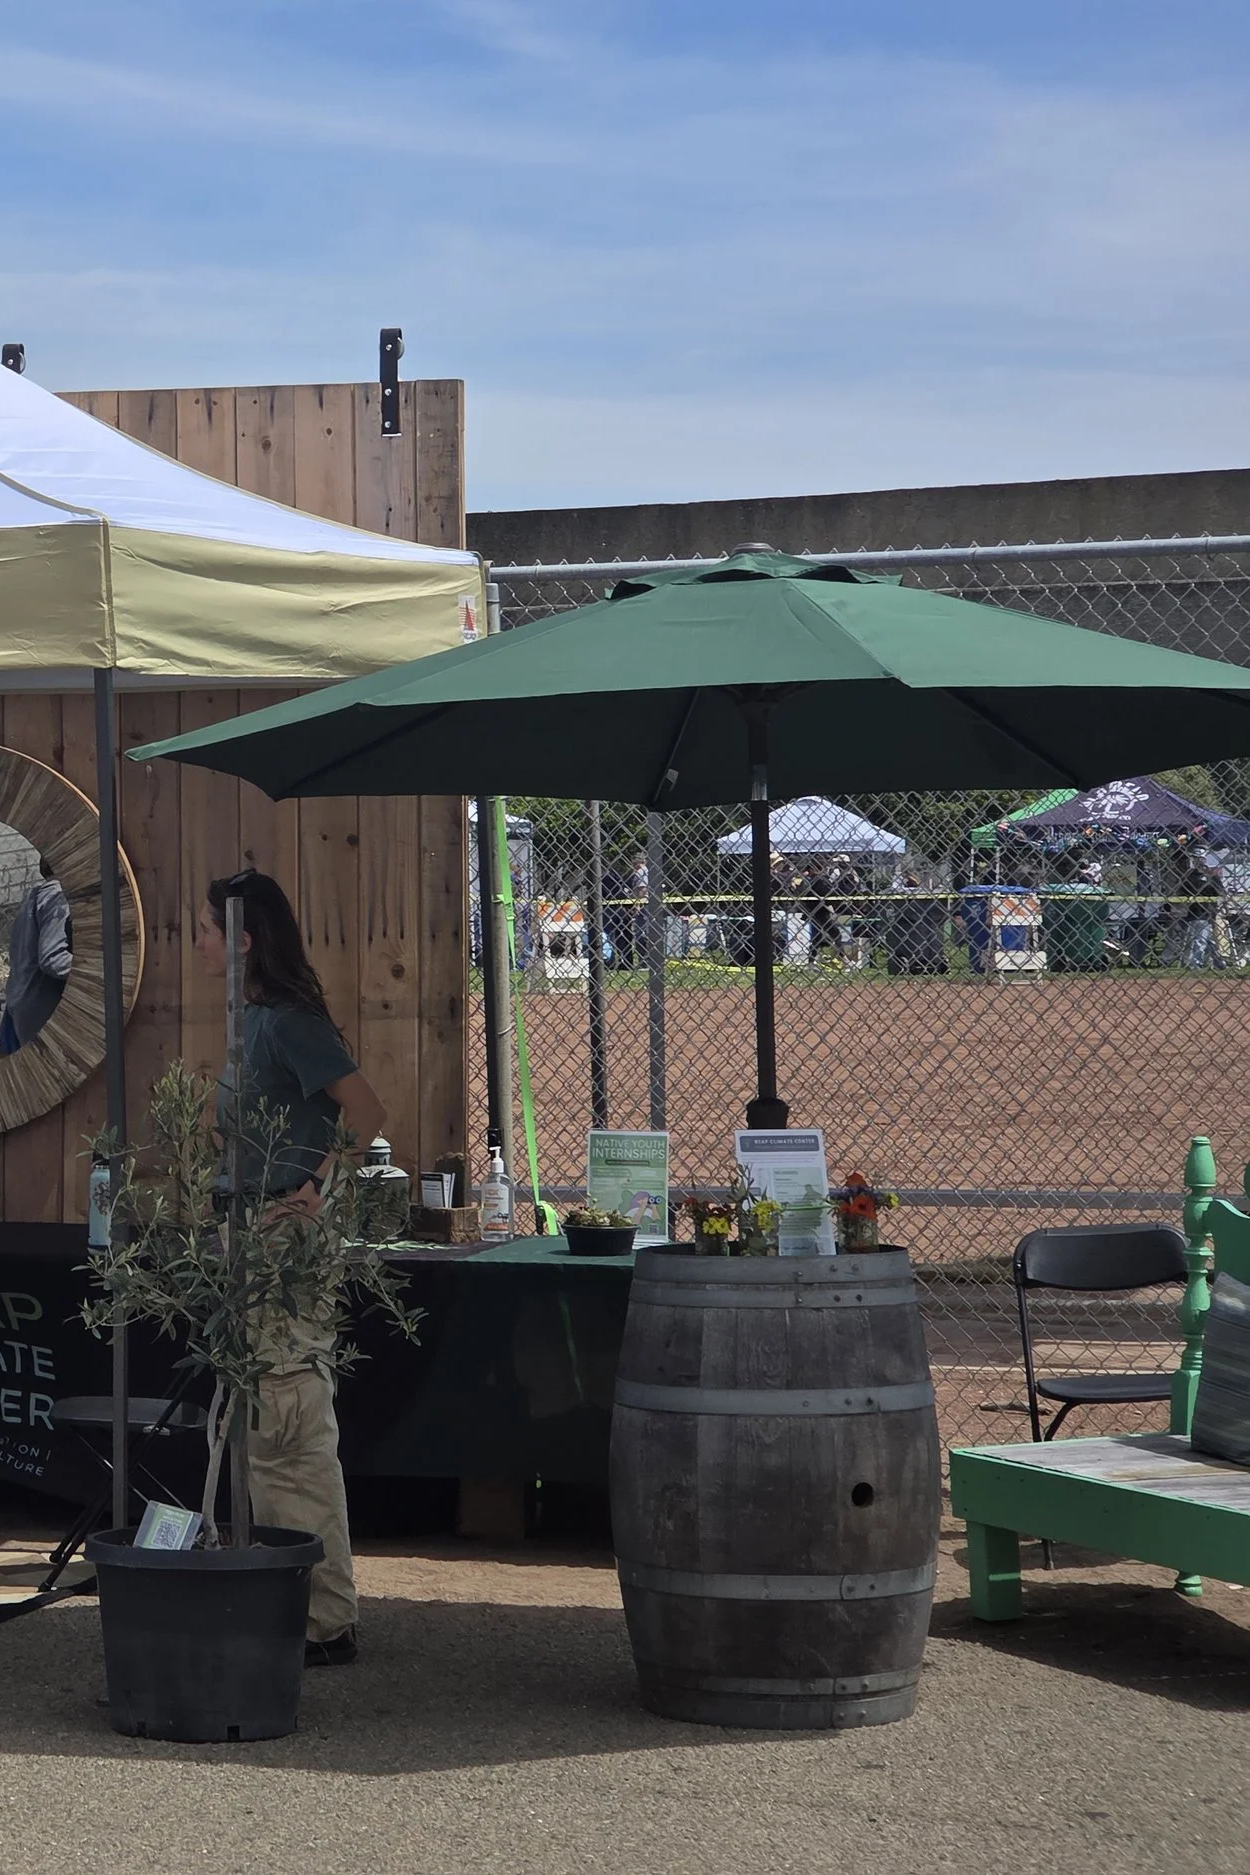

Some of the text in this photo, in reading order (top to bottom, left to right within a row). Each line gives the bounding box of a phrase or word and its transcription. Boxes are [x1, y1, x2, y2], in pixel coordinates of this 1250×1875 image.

[596, 1139, 665, 1149] NATIVE YOUTH
[592, 1148, 665, 1159] INTERNSHIPS
